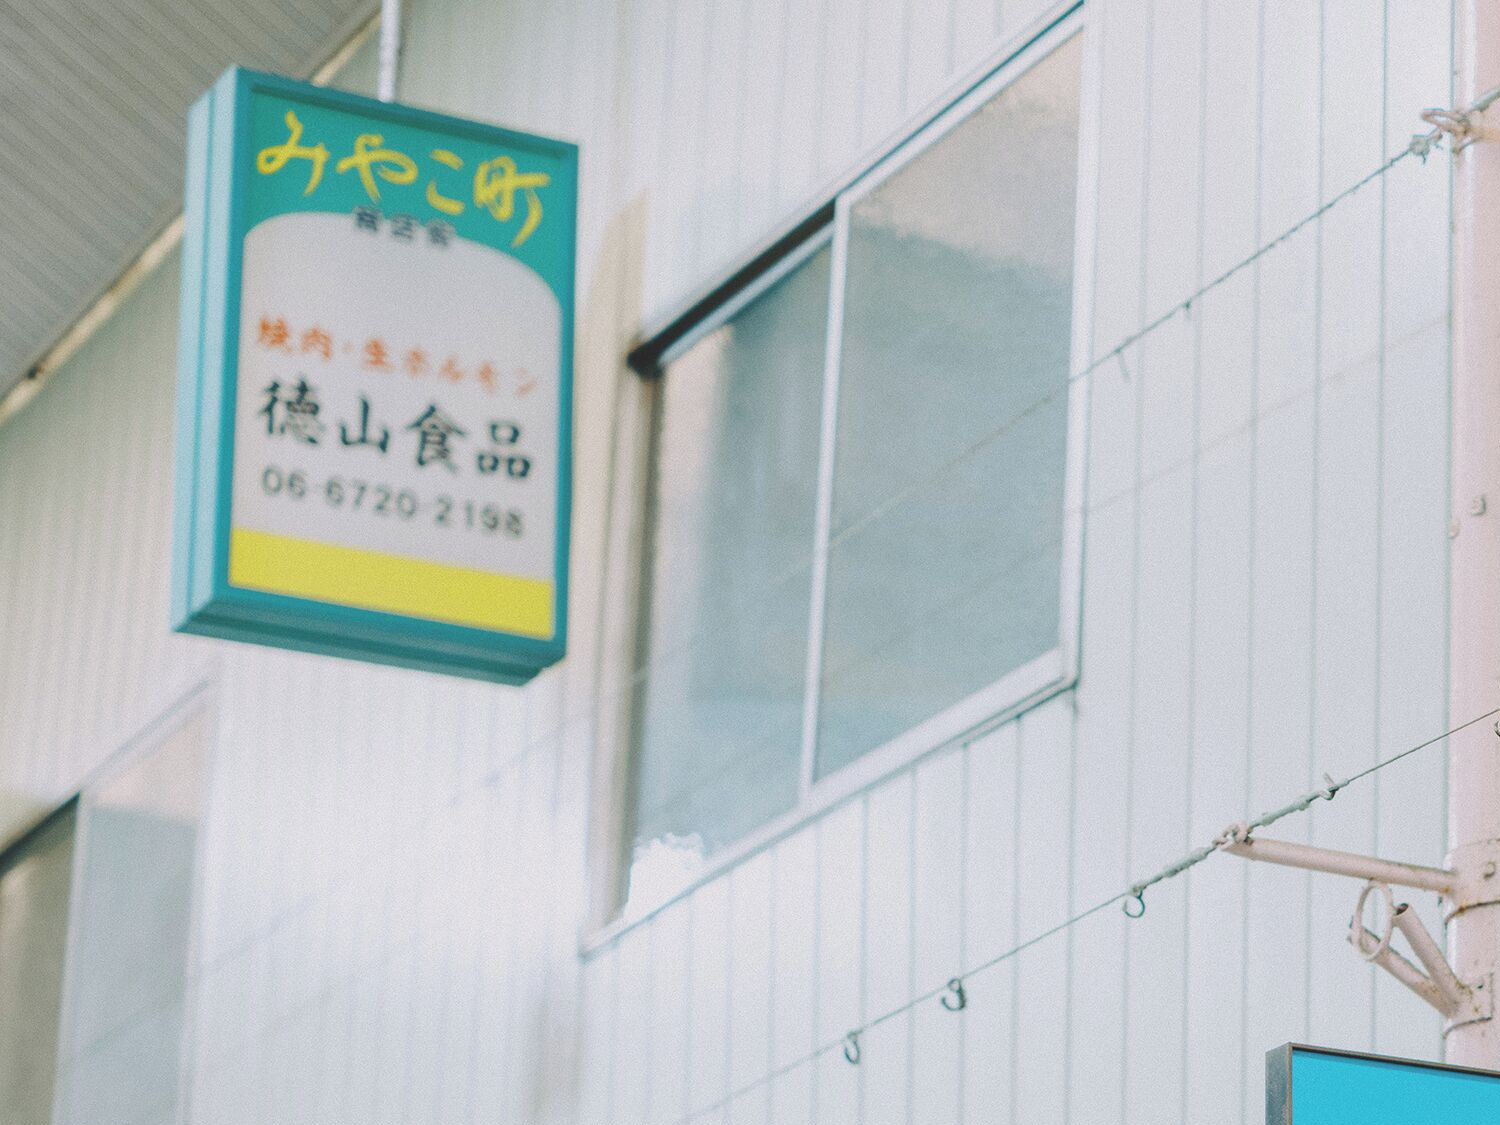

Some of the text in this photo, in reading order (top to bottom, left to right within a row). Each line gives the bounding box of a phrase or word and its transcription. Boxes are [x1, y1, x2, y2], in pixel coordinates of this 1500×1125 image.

[256, 112, 550, 247] みやこ町
[259, 376, 532, 479] 徳山食品
